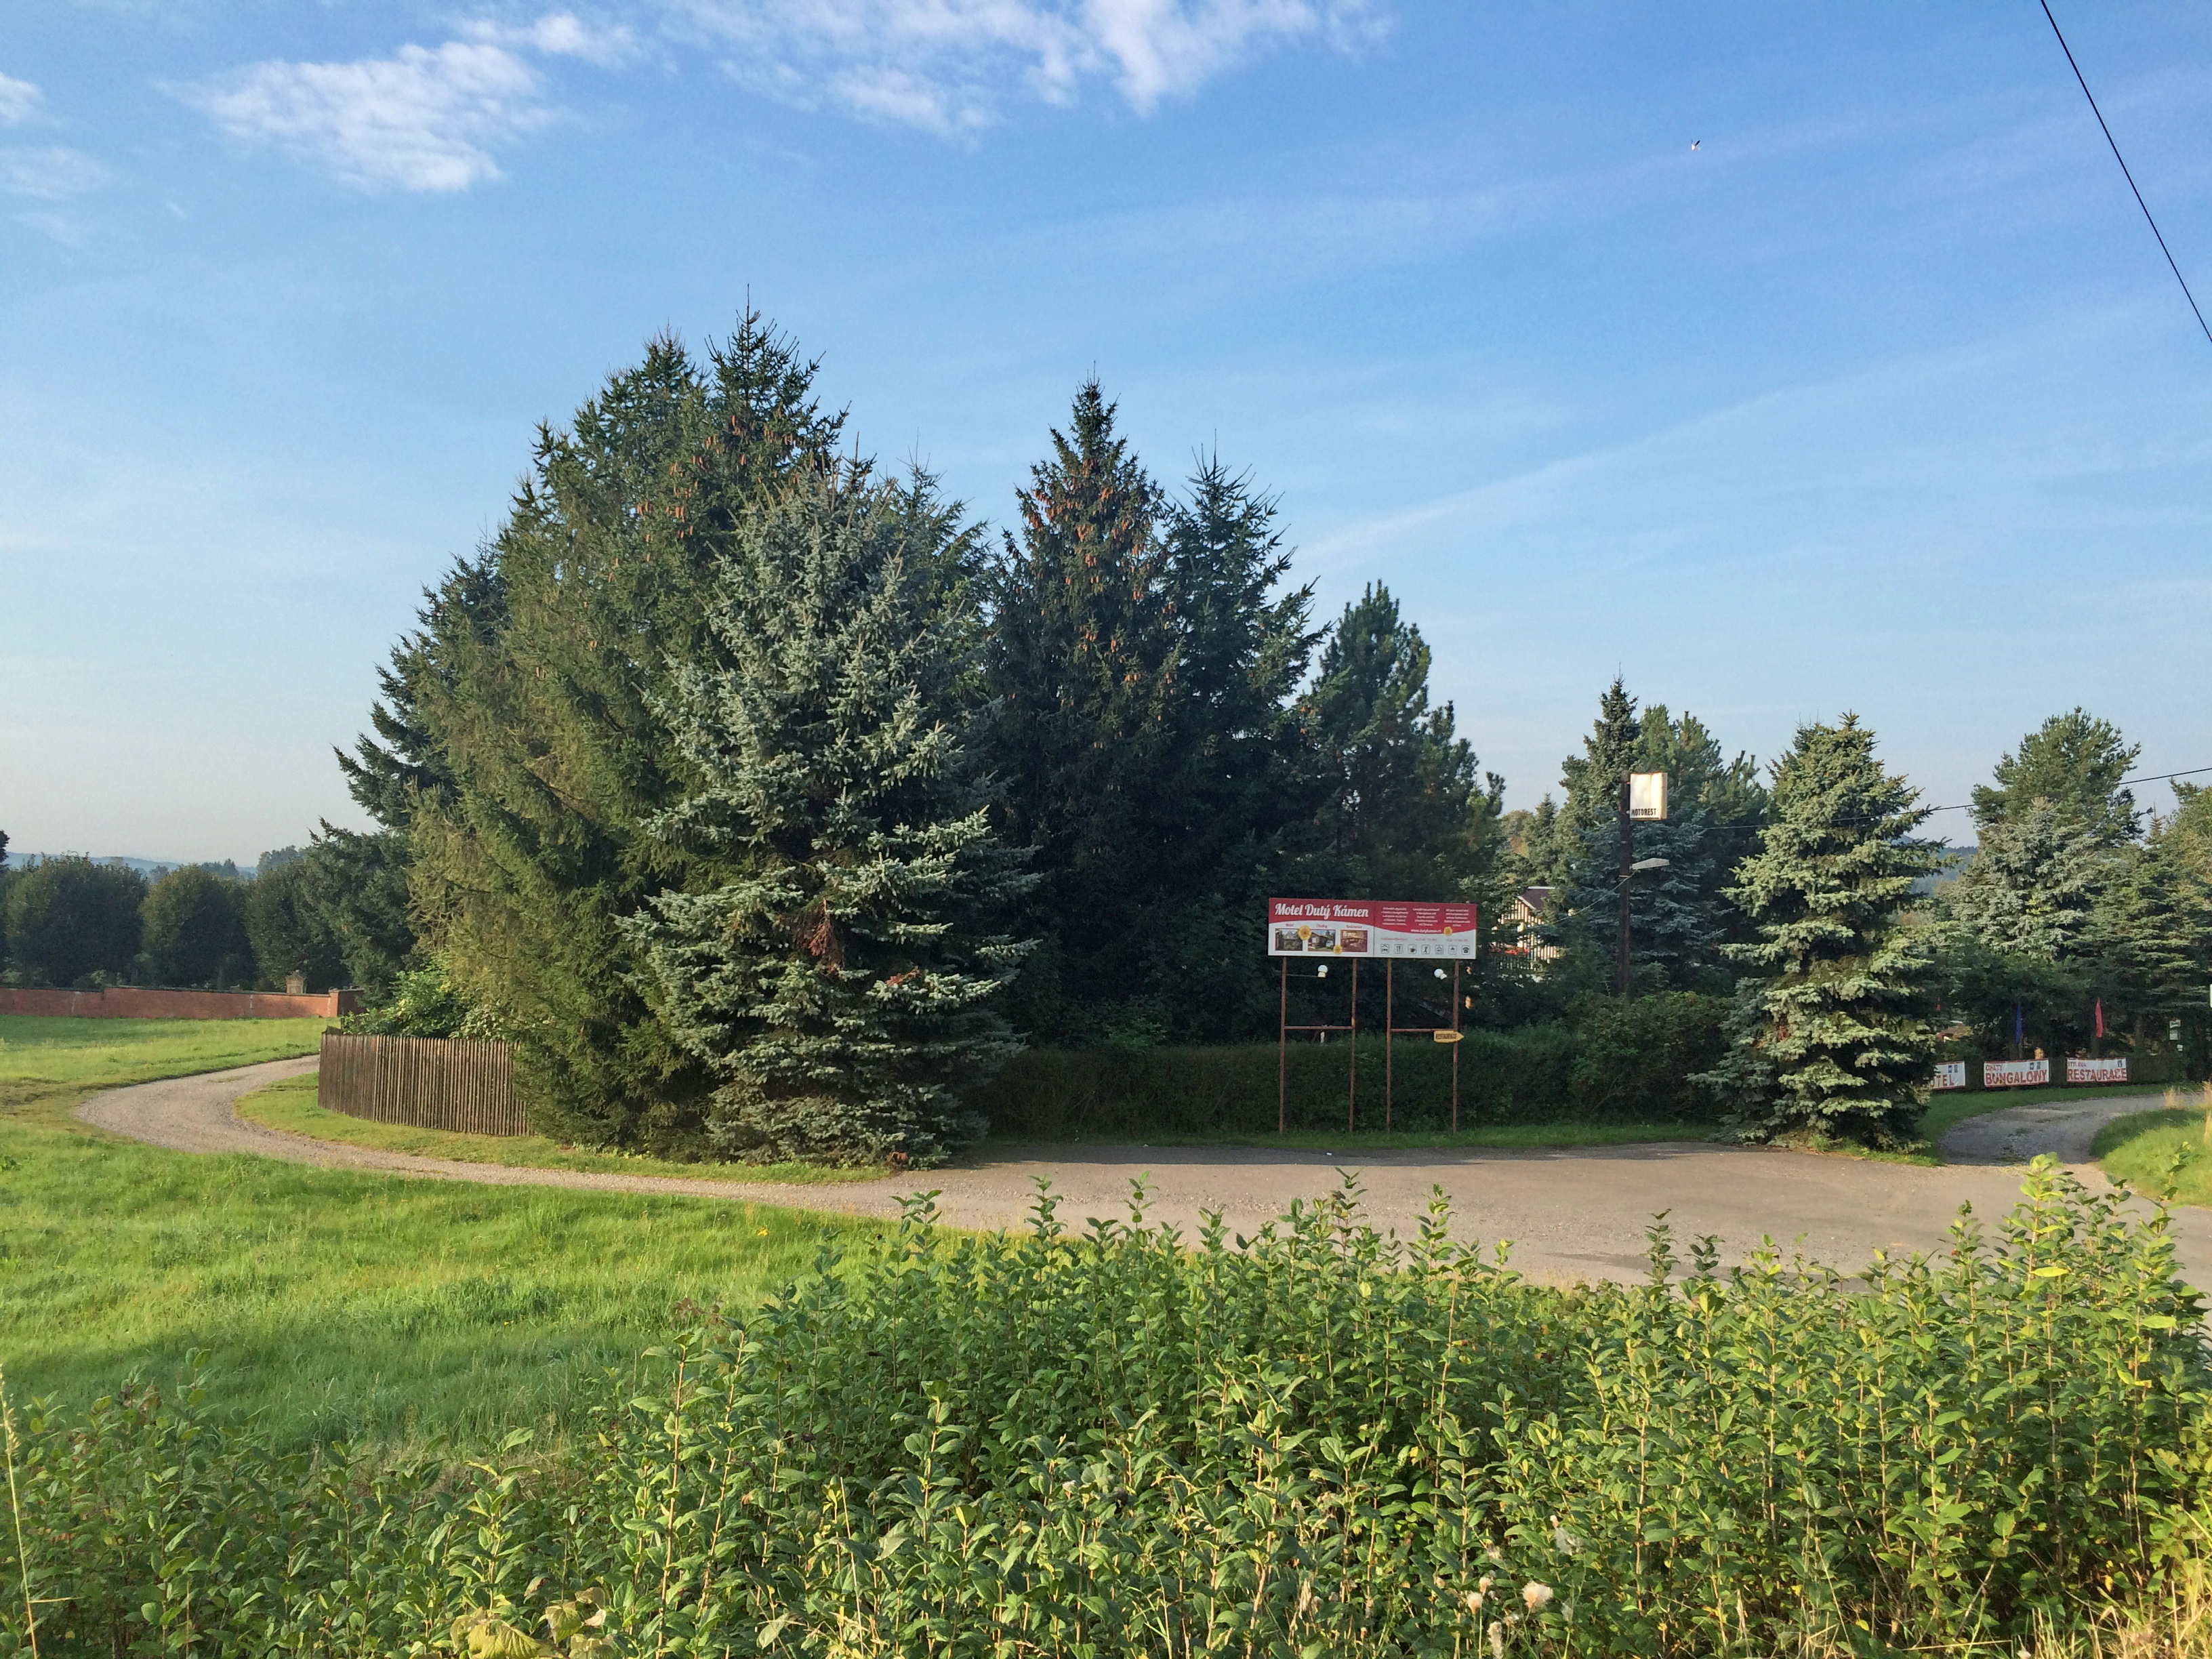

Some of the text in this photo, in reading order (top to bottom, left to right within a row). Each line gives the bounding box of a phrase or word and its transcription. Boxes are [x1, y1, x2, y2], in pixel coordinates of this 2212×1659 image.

[1631, 808, 1657, 816] MOTOREST
[1275, 903, 1303, 916] Motel
[1305, 903, 1331, 920] Dutý
[1333, 905, 1369, 918] Kámen
[2067, 1068, 2127, 1081] RESTAURACE
